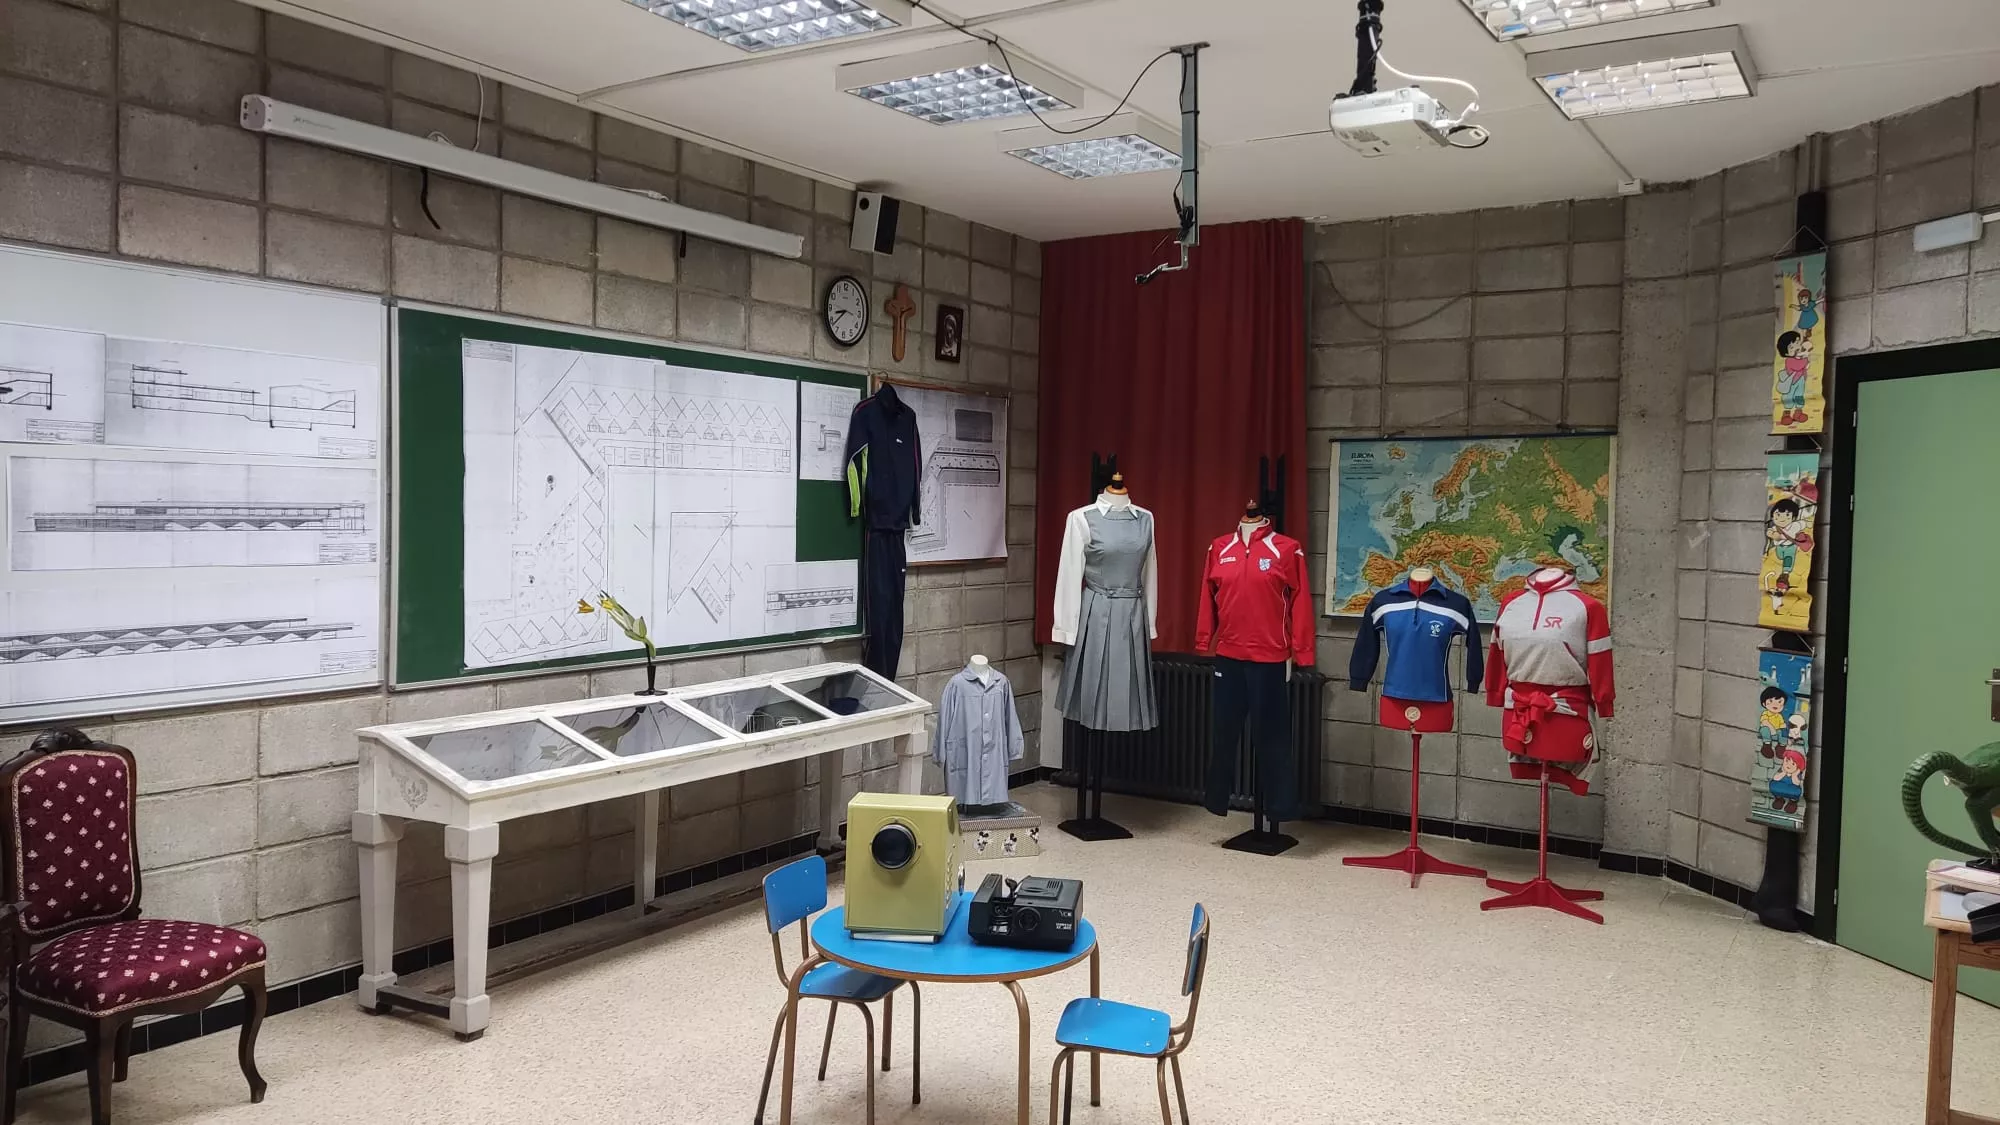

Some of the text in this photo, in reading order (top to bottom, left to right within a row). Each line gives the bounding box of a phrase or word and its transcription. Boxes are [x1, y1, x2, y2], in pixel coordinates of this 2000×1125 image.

[843, 282, 849, 291] 12
[856, 298, 860, 306] 2
[828, 303, 832, 312] 9
[857, 310, 861, 318] 3
[841, 331, 846, 339] 6
[849, 328, 853, 337] 5
[1544, 617, 1562, 630] SR
